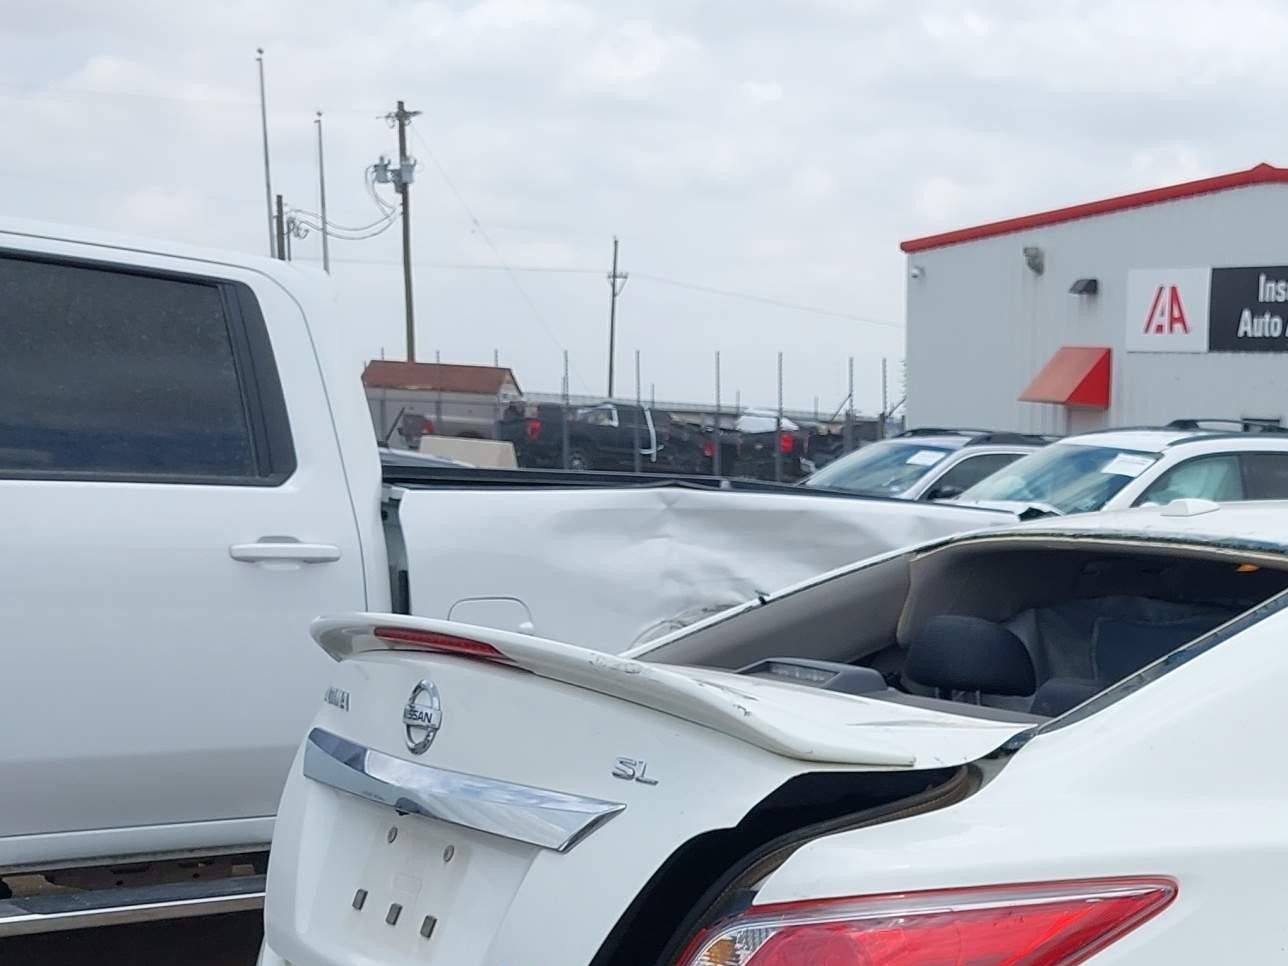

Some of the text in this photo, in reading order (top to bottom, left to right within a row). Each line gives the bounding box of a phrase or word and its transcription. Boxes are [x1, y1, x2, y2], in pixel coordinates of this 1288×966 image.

[1237, 308, 1283, 338] Auto
[403, 707, 433, 724] SSAN
[612, 757, 659, 786] SL
